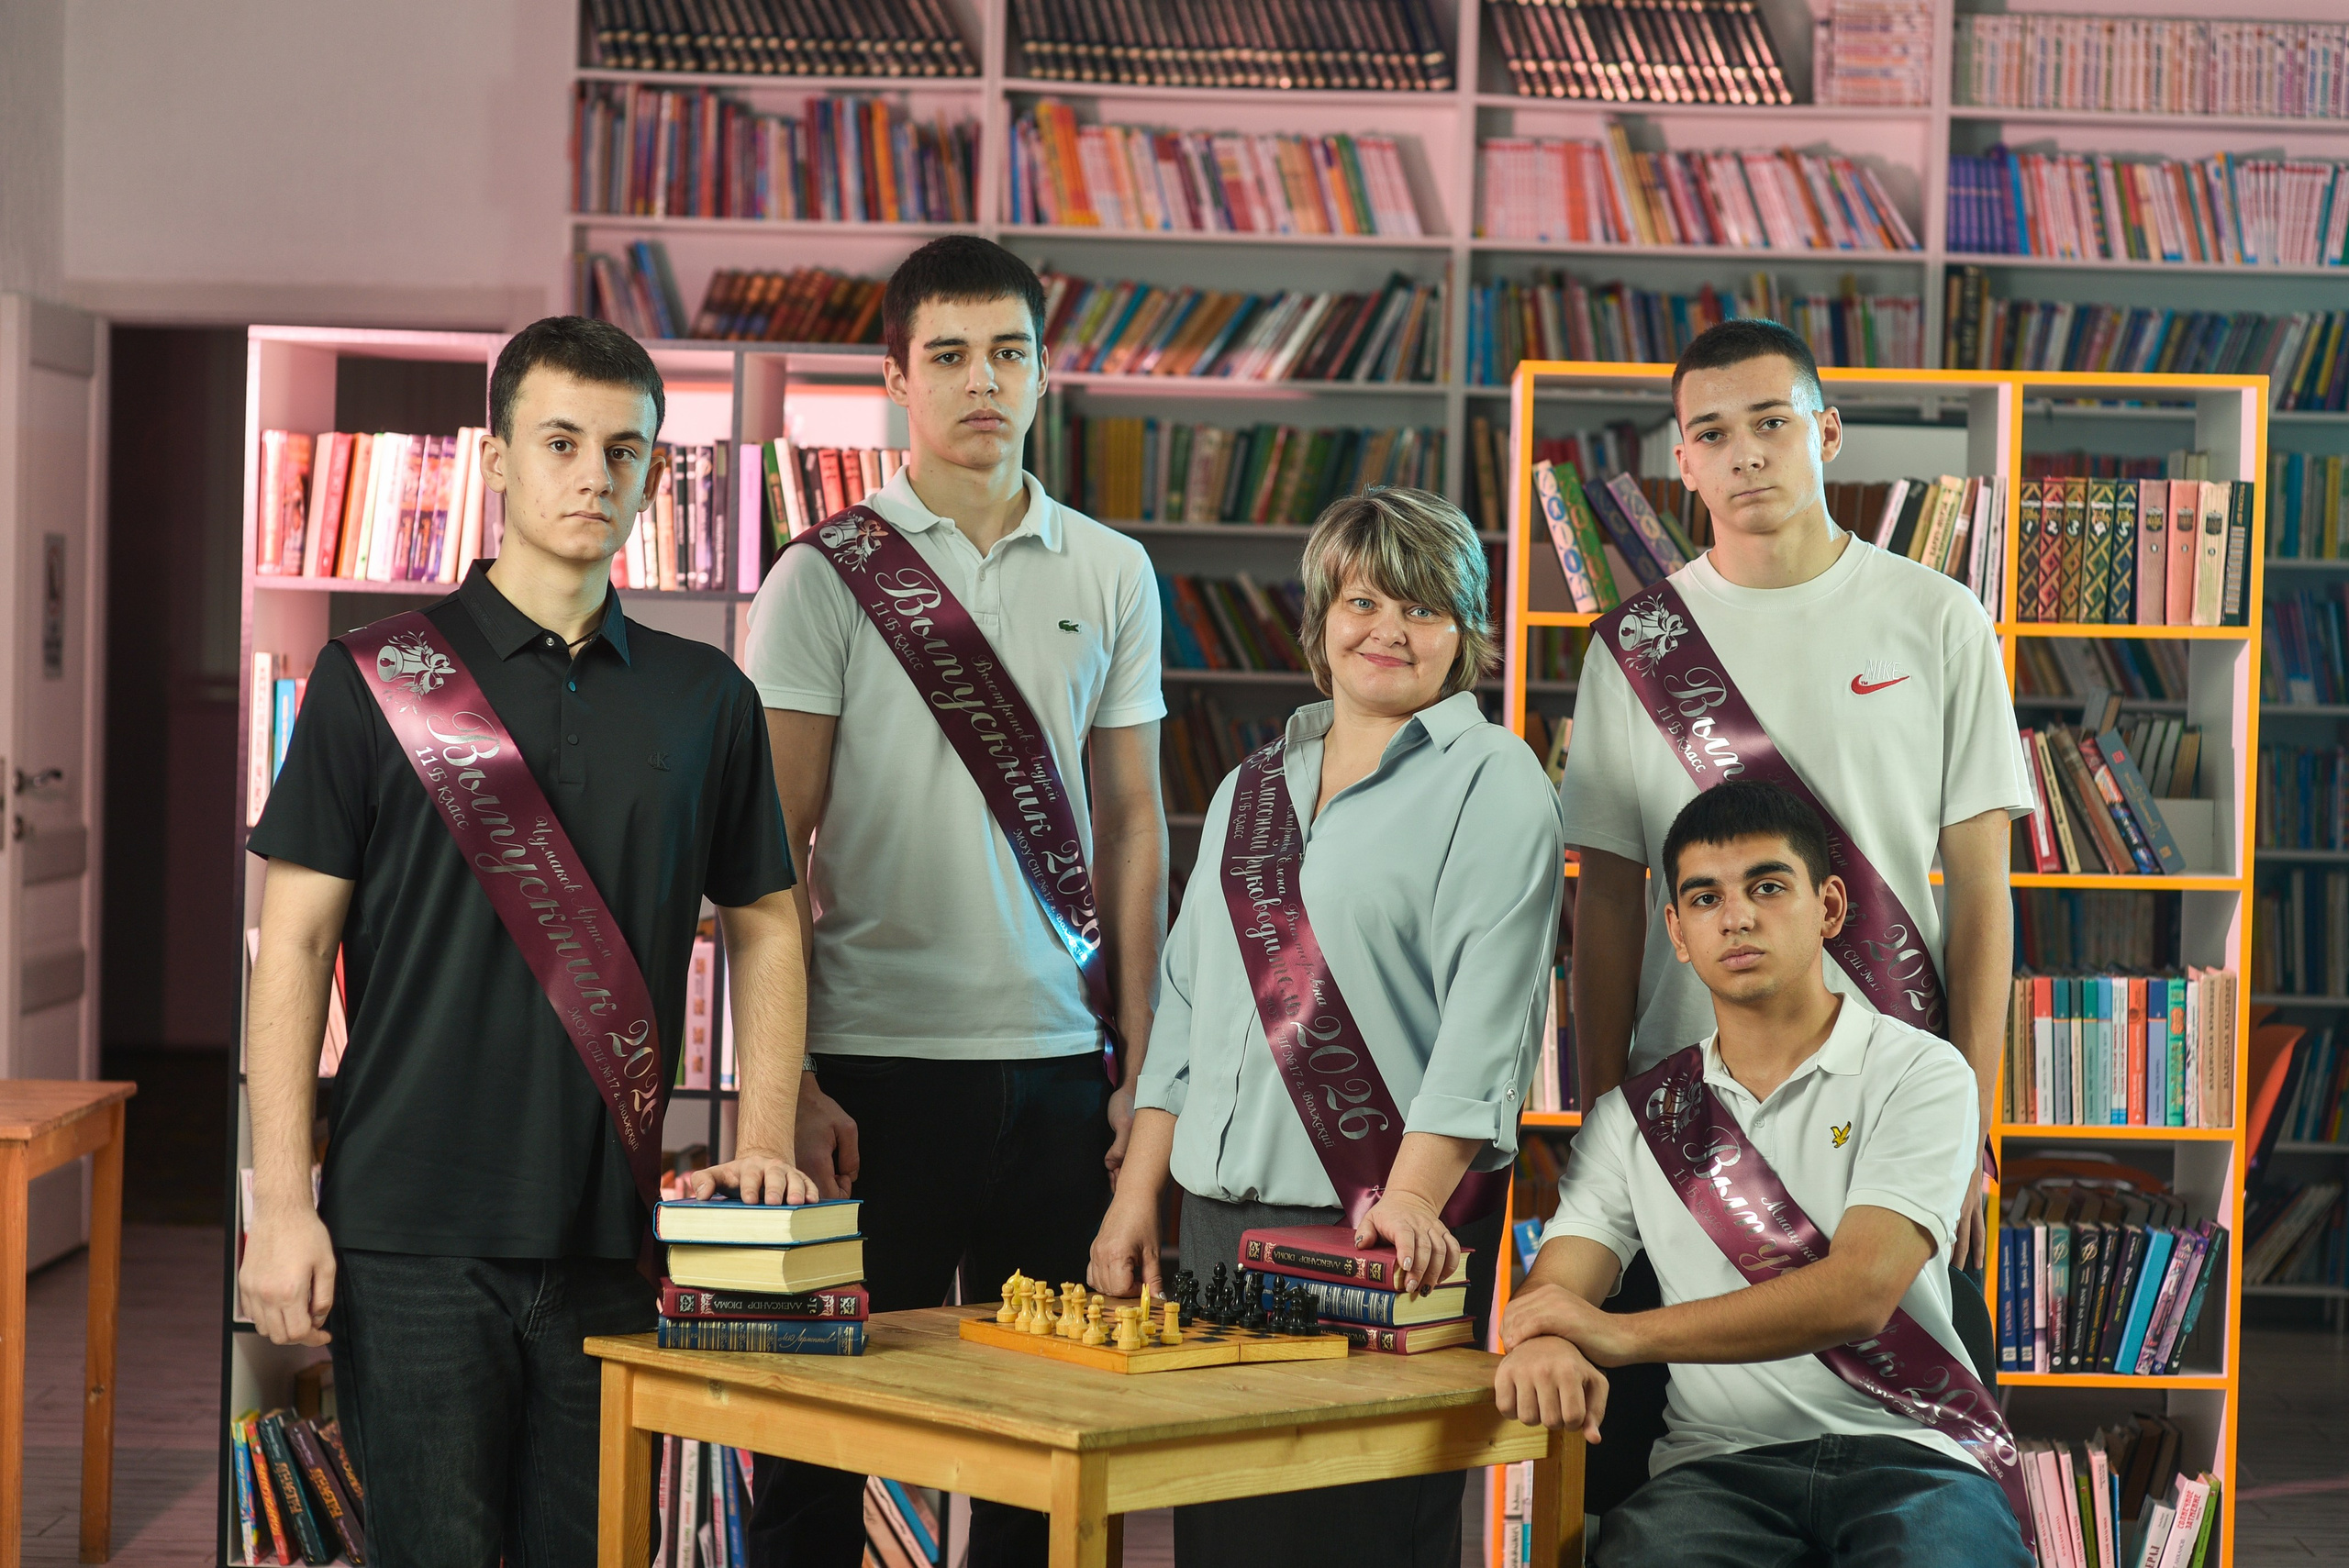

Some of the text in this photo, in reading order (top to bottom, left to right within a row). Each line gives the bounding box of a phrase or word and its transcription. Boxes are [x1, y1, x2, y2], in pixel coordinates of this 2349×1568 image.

[870, 600, 926, 671] 11 Б класс
[1864, 659, 1900, 680] NIKE
[874, 568, 1101, 951] Выпускник 2026
[1656, 705, 1707, 773] 11 Б класс
[415, 746, 469, 830] 11 Б класс
[1025, 745, 1061, 803] Андрей
[1233, 789, 1252, 839] 11 Б класс
[527, 815, 584, 894] Чумаков
[1013, 828, 1034, 857] МОУ
[1028, 857, 1043, 881] СШ
[1037, 879, 1054, 902] №17
[1275, 853, 1291, 896] Елена
[426, 711, 661, 1135] Выпускник 2026
[1230, 762, 1389, 1140] Классный руководитель 2026
[1843, 949, 1863, 971] СШ
[1861, 924, 1943, 1032] 2026
[568, 1006, 596, 1038] МОУ
[585, 1040, 607, 1063] СШ
[599, 1063, 620, 1089] №17
[618, 1100, 640, 1152] Волжский
[1282, 1051, 1304, 1078] №17
[1302, 1090, 1335, 1149] Волжский
[1673, 1168, 1727, 1236] 11 Б класс
[1760, 1195, 1820, 1262] Мнацака
[1298, 1255, 1341, 1270] АЛЕКСАНДР
[713, 1300, 743, 1310] ДЮМА
[747, 1301, 803, 1310] АЛЕКСАНДР
[1901, 1365, 2018, 1467] 2026
[2176, 1489, 2194, 1529] СОЛНЕЧНОЕ
[2185, 1493, 2201, 1530] ЗАТМЕНИЕ
